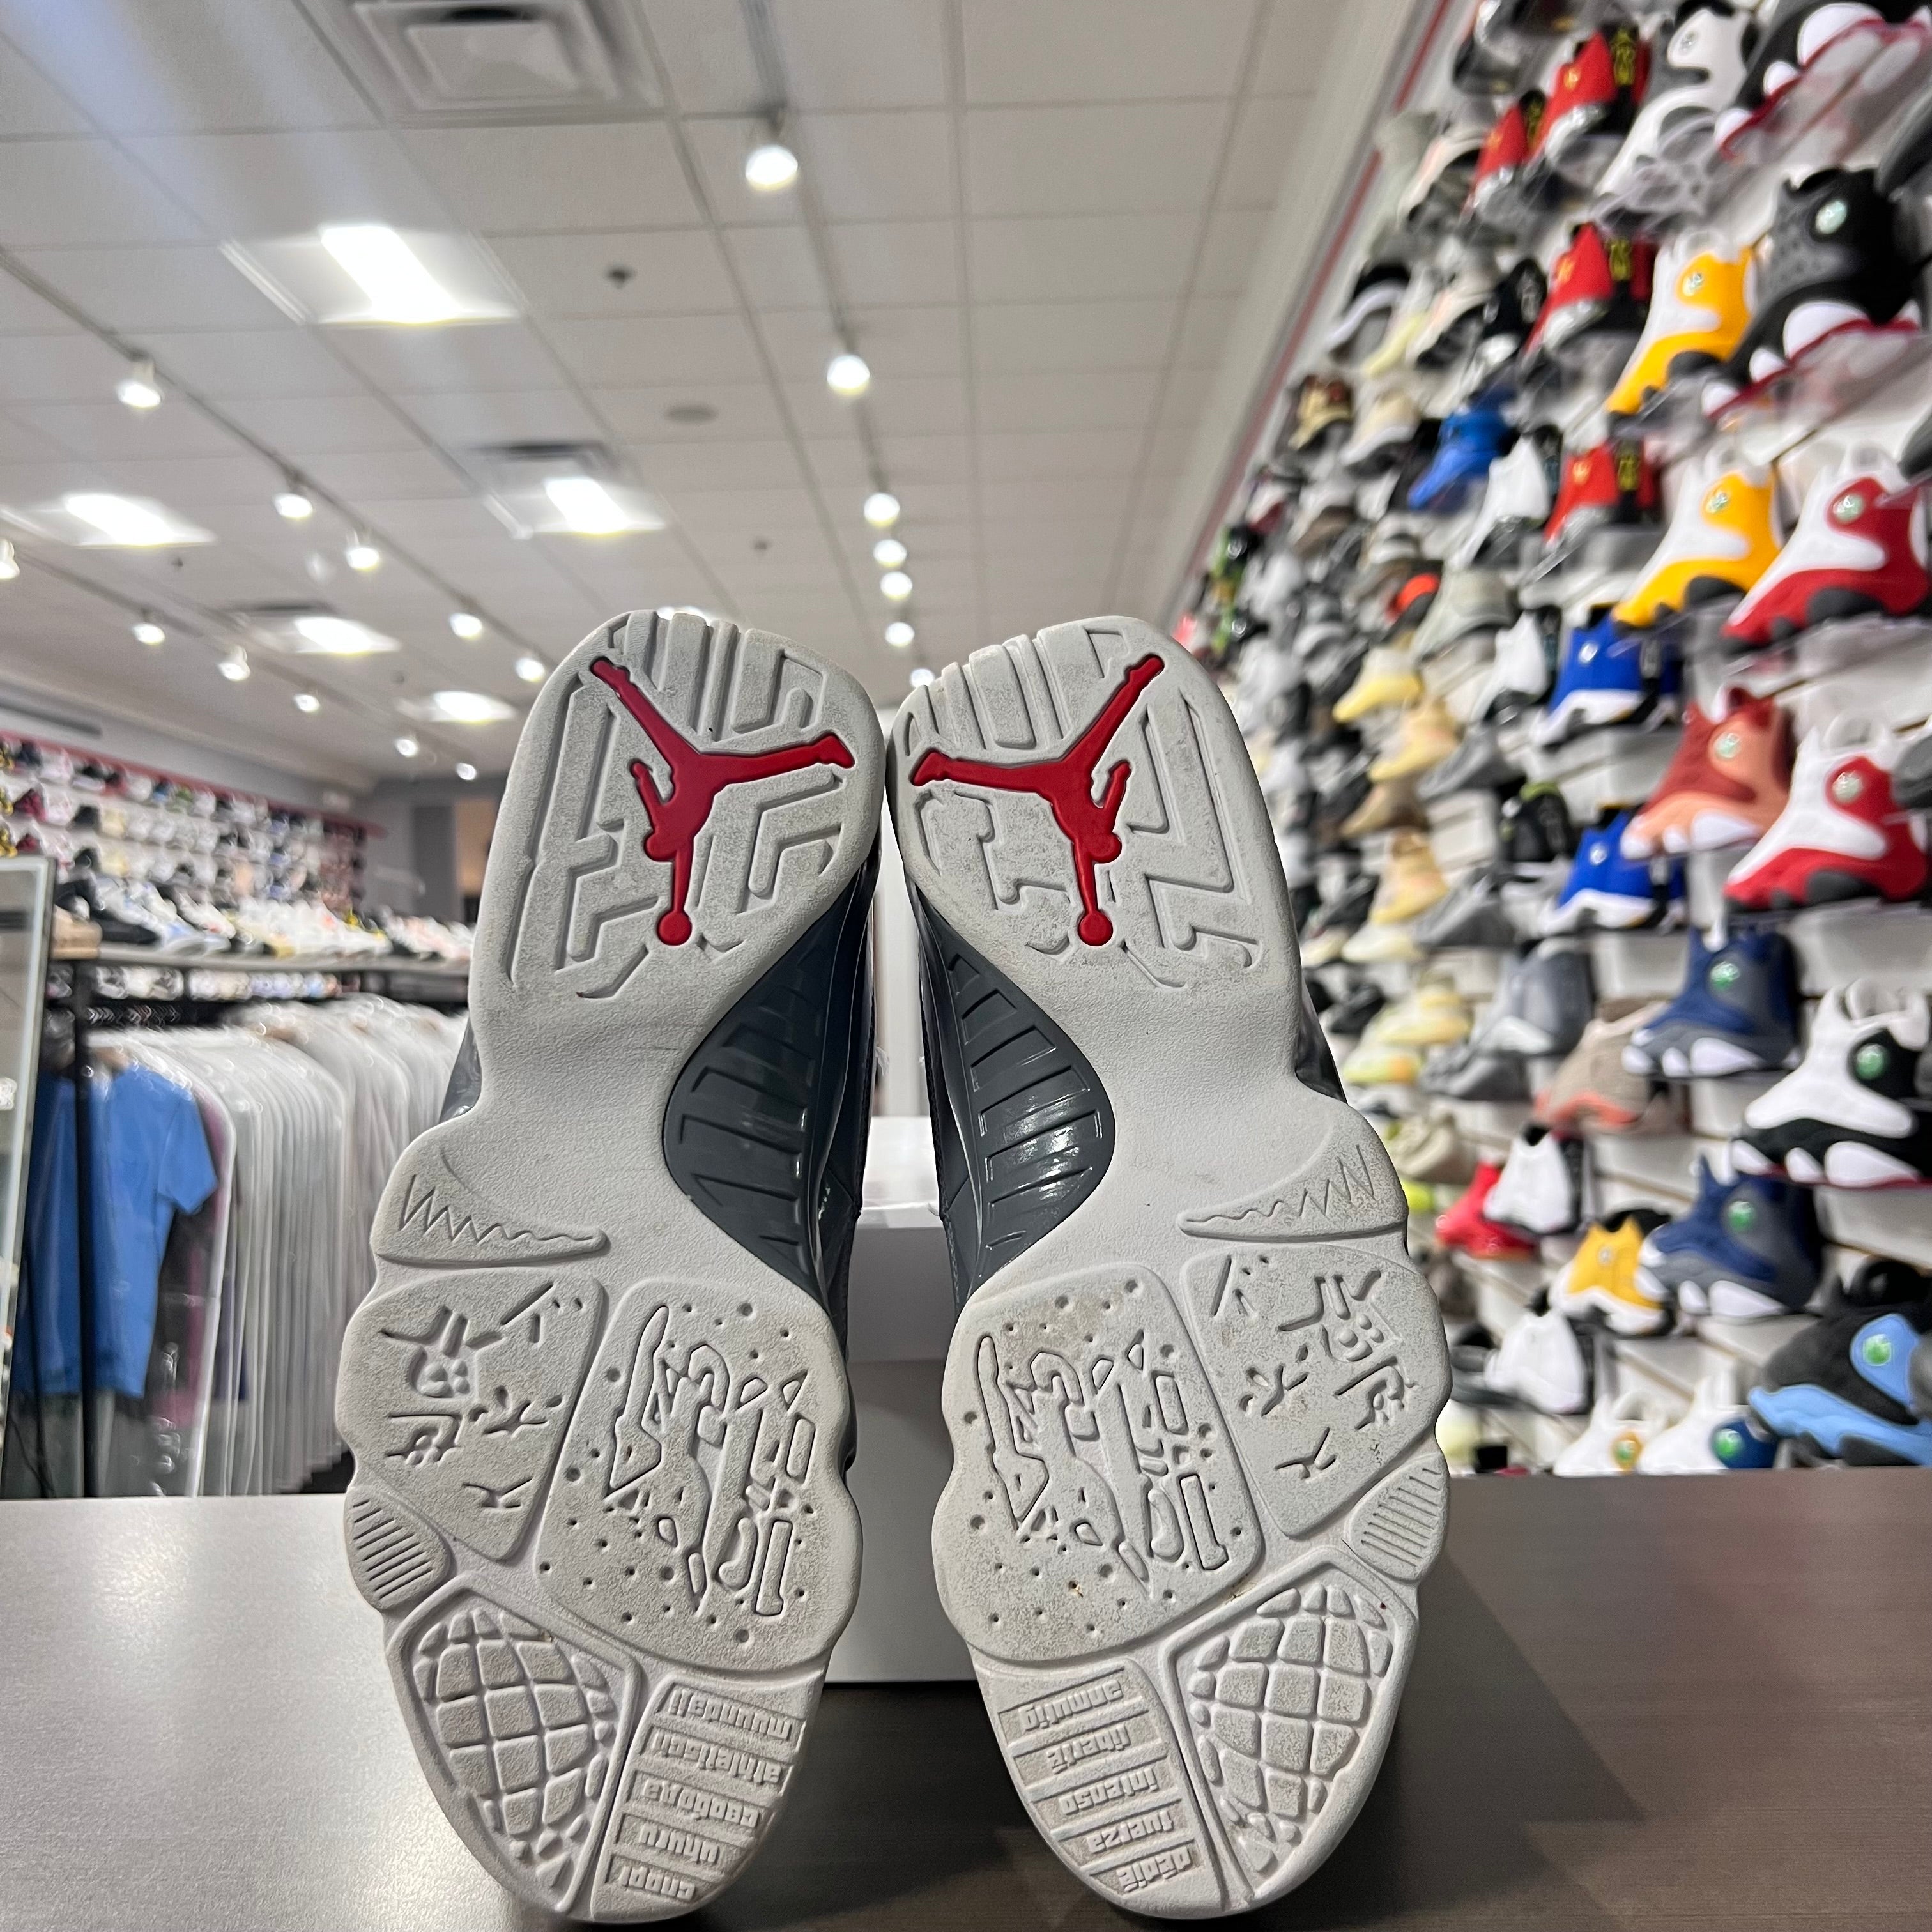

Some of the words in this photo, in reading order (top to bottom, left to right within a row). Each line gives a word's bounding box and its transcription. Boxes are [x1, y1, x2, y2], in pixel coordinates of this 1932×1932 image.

[668, 1688, 793, 1741] muundaji
[1018, 1680, 1124, 1731] anmutig
[652, 1731, 782, 1786] athletisch
[1059, 1767, 1158, 1815] intenso
[638, 1823, 721, 1864] uhuru
[1086, 1810, 1174, 1854] fuerza
